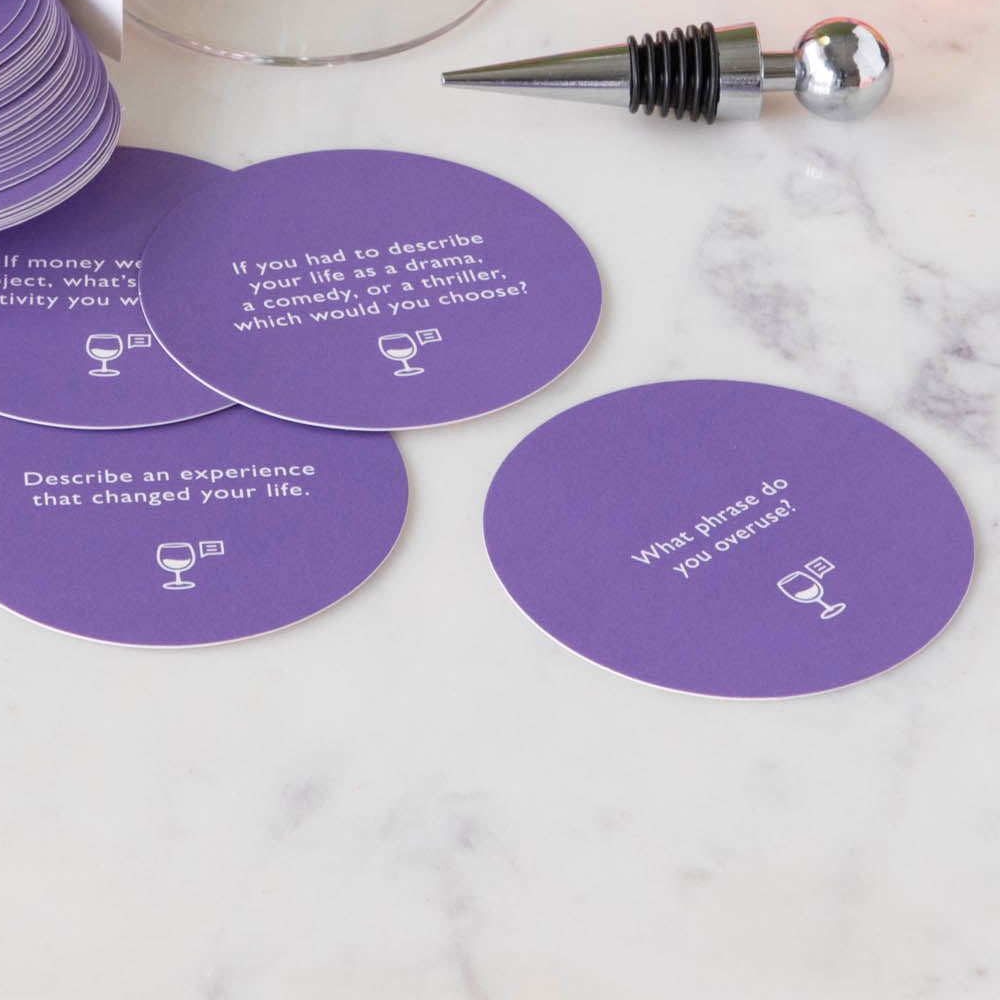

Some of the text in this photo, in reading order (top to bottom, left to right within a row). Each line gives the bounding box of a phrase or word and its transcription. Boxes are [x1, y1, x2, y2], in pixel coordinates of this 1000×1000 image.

[4, 255, 20, 268] If
[28, 259, 105, 273] money
[232, 232, 485, 276] If you had to describe
[248, 252, 484, 295] your life as a drama,
[63, 274, 137, 288] what's
[241, 267, 507, 312] a comedy, or a thriller,
[68, 296, 110, 310] you
[232, 281, 529, 333] which would you choose?
[23, 463, 317, 487] Describe an experience
[32, 482, 311, 507] that changed your life.
[631, 478, 788, 565] What phrase do
[672, 499, 797, 580] you overuse?
